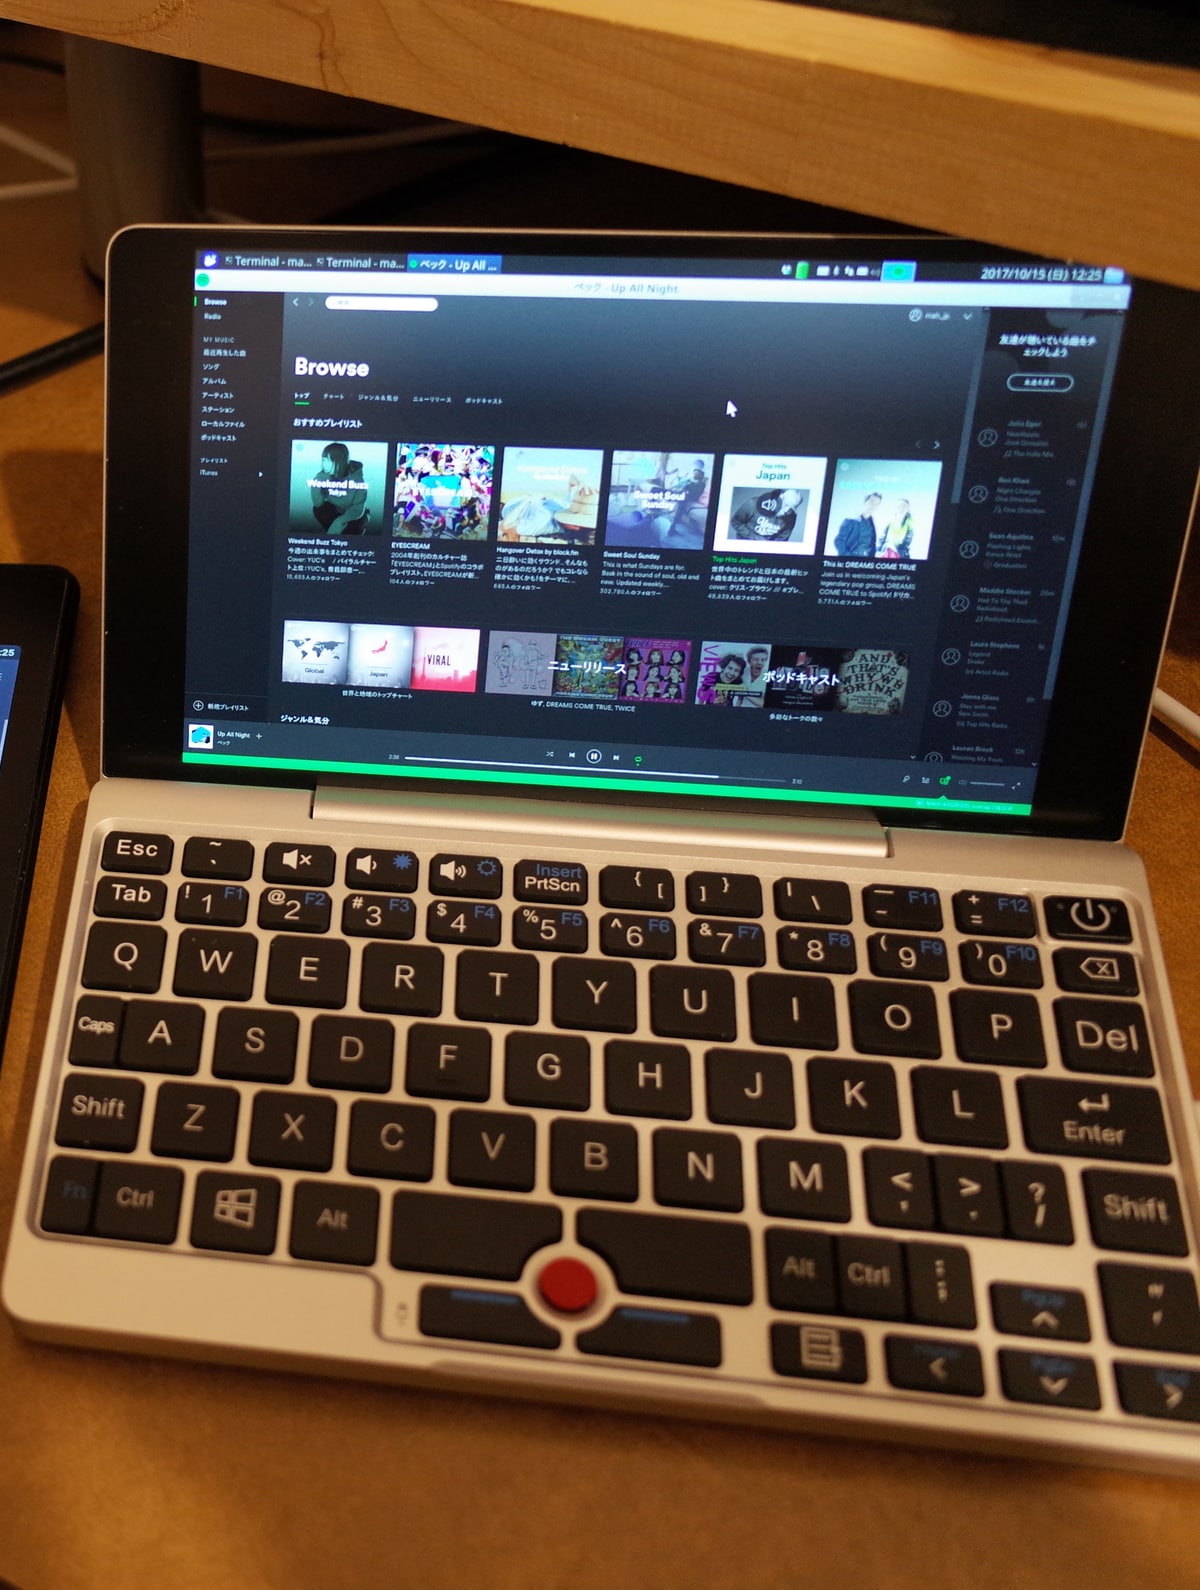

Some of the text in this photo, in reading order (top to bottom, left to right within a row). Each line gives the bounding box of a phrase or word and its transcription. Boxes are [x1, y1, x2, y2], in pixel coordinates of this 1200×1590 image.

[235, 257, 277, 267] Terminal
[327, 257, 371, 268] Terminal
[420, 260, 486, 271] ベック Up All
[981, 267, 1046, 279] 2017/10/15
[1072, 269, 1101, 280] 12:25
[611, 284, 626, 293] Up
[629, 284, 643, 293] All
[648, 285, 679, 294] Night
[204, 298, 227, 306] Browse
[294, 357, 370, 378] Browse
[293, 418, 363, 429] おすすめプレイリスト
[307, 480, 369, 489] Weekend Buzz
[756, 471, 790, 481] Japan
[328, 488, 347, 496] Tokyo
[634, 491, 686, 500] Sweet Soul
[641, 500, 675, 510] Sunday
[638, 552, 660, 560] Sunday
[737, 557, 757, 565] Japan
[845, 561, 916, 571] DREAMS COME TRUE
[427, 654, 451, 666] VIRAL
[548, 661, 627, 674] ニューリリース
[859, 654, 890, 663] AND
[763, 671, 840, 686] ポッドキャスト
[280, 714, 329, 725] ジャンル&気分
[218, 730, 226, 738] Up
[117, 840, 158, 857] Esc
[536, 864, 582, 879] Insert
[112, 884, 151, 902] Tab
[224, 887, 243, 900] F1
[525, 877, 580, 892] PrtScn
[202, 894, 212, 913] 1
[305, 892, 326, 906] F2
[389, 899, 409, 912] F3
[908, 890, 939, 905] F11
[998, 898, 1029, 913] F12
[284, 900, 301, 920] 2
[366, 906, 382, 926] 3
[474, 906, 494, 919] F4
[561, 913, 582, 926] F5
[450, 913, 466, 933] 4
[540, 919, 557, 940] 5
[649, 919, 670, 933] F6
[738, 926, 759, 939] F7
[626, 926, 643, 947] 6
[717, 933, 733, 953] 7
[828, 933, 850, 947] F8
[113, 942, 138, 971] Q
[807, 940, 824, 961] 8
[920, 940, 944, 954] F9
[1006, 945, 1036, 961] F10
[200, 949, 233, 973] W
[898, 947, 917, 970] 9
[988, 954, 1008, 976] 0
[300, 957, 319, 982] E
[394, 965, 415, 989] R
[489, 972, 509, 996] T
[585, 980, 608, 1004] Y
[684, 988, 707, 1014] U
[792, 996, 798, 1022] I
[78, 1016, 115, 1035] Caps
[884, 1004, 912, 1031] O
[990, 1013, 1013, 1040] P
[148, 1020, 172, 1046] A
[245, 1027, 265, 1053] S
[1075, 1020, 1139, 1054] Del
[339, 1036, 364, 1062] D
[439, 1045, 458, 1070] F
[537, 1053, 562, 1080] G
[638, 1062, 662, 1089] H
[744, 1072, 763, 1098] J
[844, 1079, 869, 1108] K
[71, 1095, 125, 1119] Shift
[952, 1089, 975, 1119] L
[183, 1104, 206, 1132] Z
[281, 1112, 306, 1142] X
[380, 1123, 405, 1151] C
[1063, 1120, 1126, 1145] Enter
[481, 1132, 505, 1160] V
[584, 1142, 608, 1171] B
[687, 1151, 714, 1182] N
[789, 1160, 823, 1192] M
[116, 1186, 154, 1208] Ctrl
[1103, 1193, 1169, 1223] Shift
[316, 1208, 348, 1230] Alt
[783, 1256, 815, 1279] Alt
[848, 1261, 891, 1286] Ctrl
